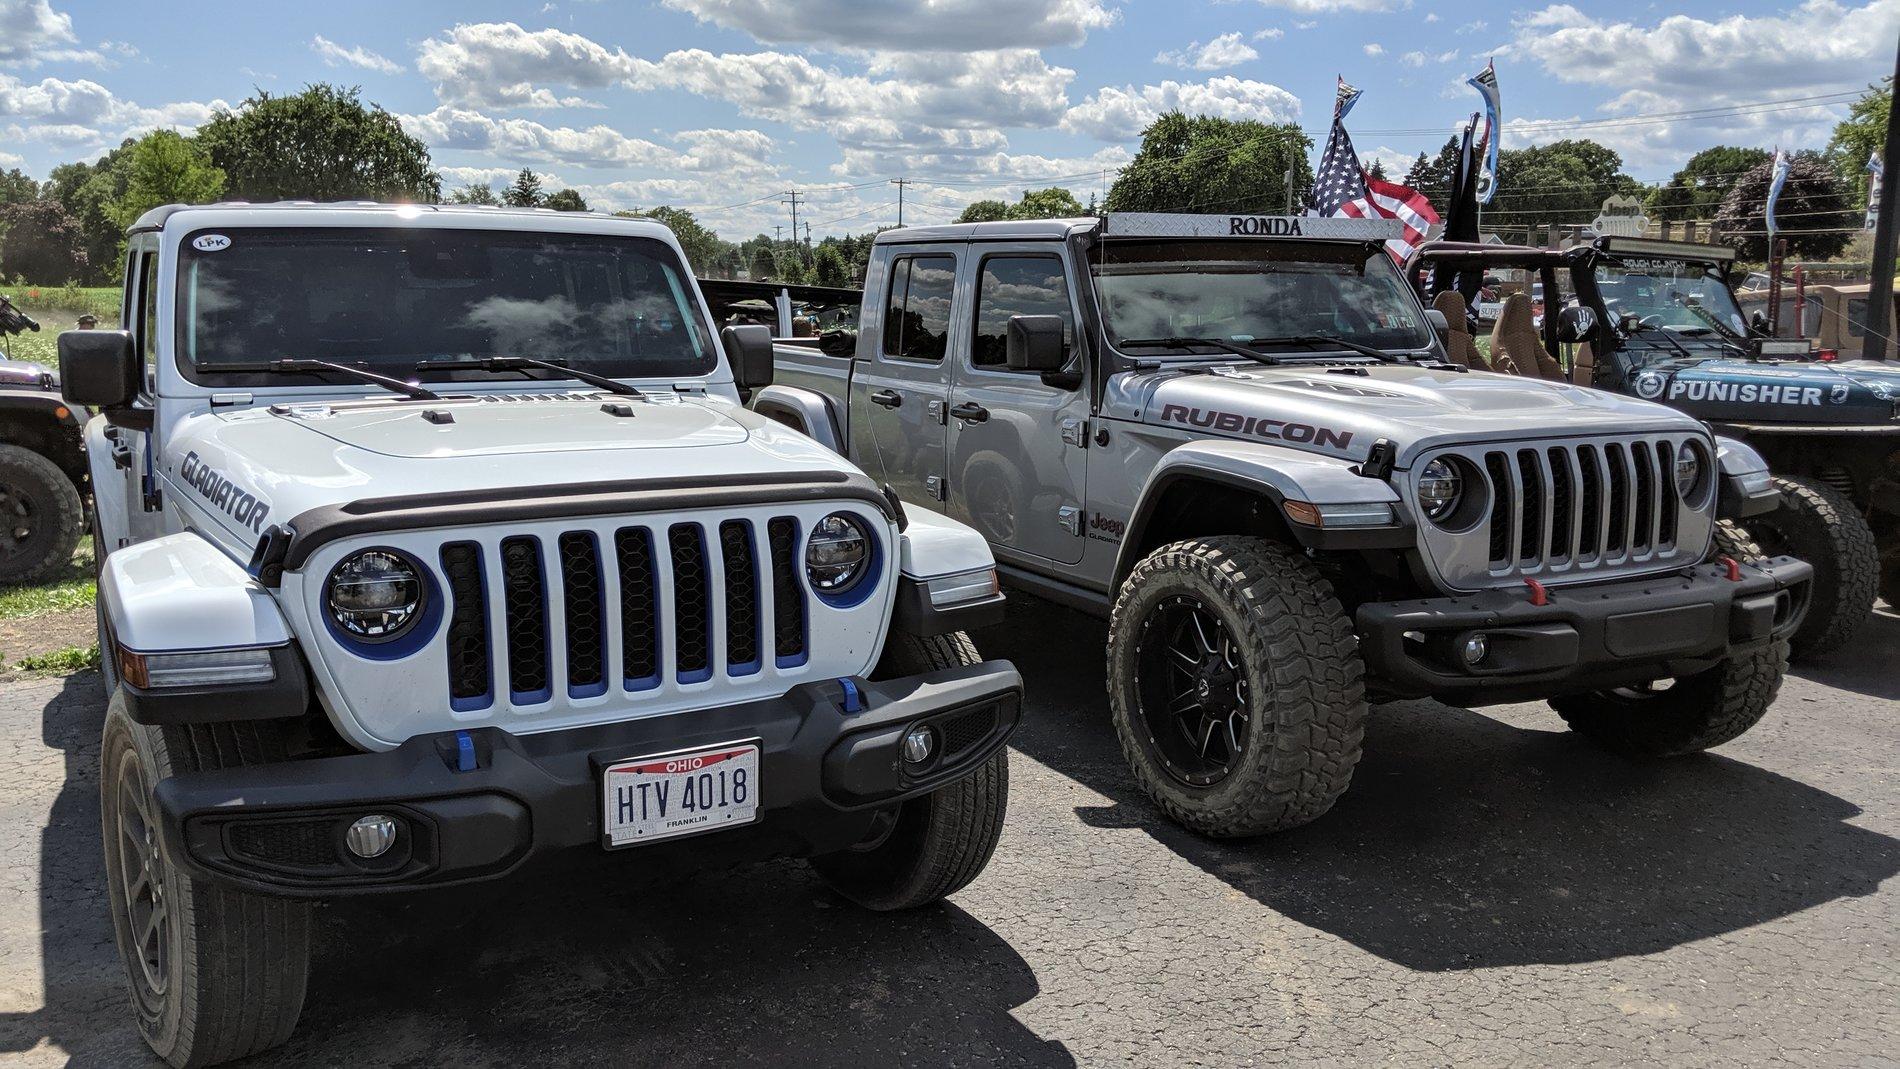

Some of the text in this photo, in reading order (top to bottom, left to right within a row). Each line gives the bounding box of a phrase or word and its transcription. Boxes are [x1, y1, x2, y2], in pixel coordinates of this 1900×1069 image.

[1602, 203, 1640, 218] Jeep
[1229, 217, 1303, 236] RONDA
[198, 239, 226, 248] LPK
[1669, 382, 1822, 405] PUNISHER
[1161, 404, 1354, 450] RUBICON
[181, 450, 270, 535] GLADIATOR
[1091, 512, 1125, 537] Jeep
[1089, 533, 1121, 546] GLADIATO
[666, 758, 703, 773] OHIO
[618, 768, 747, 824] HTV 4018
[666, 815, 708, 828] FRANKLIN
